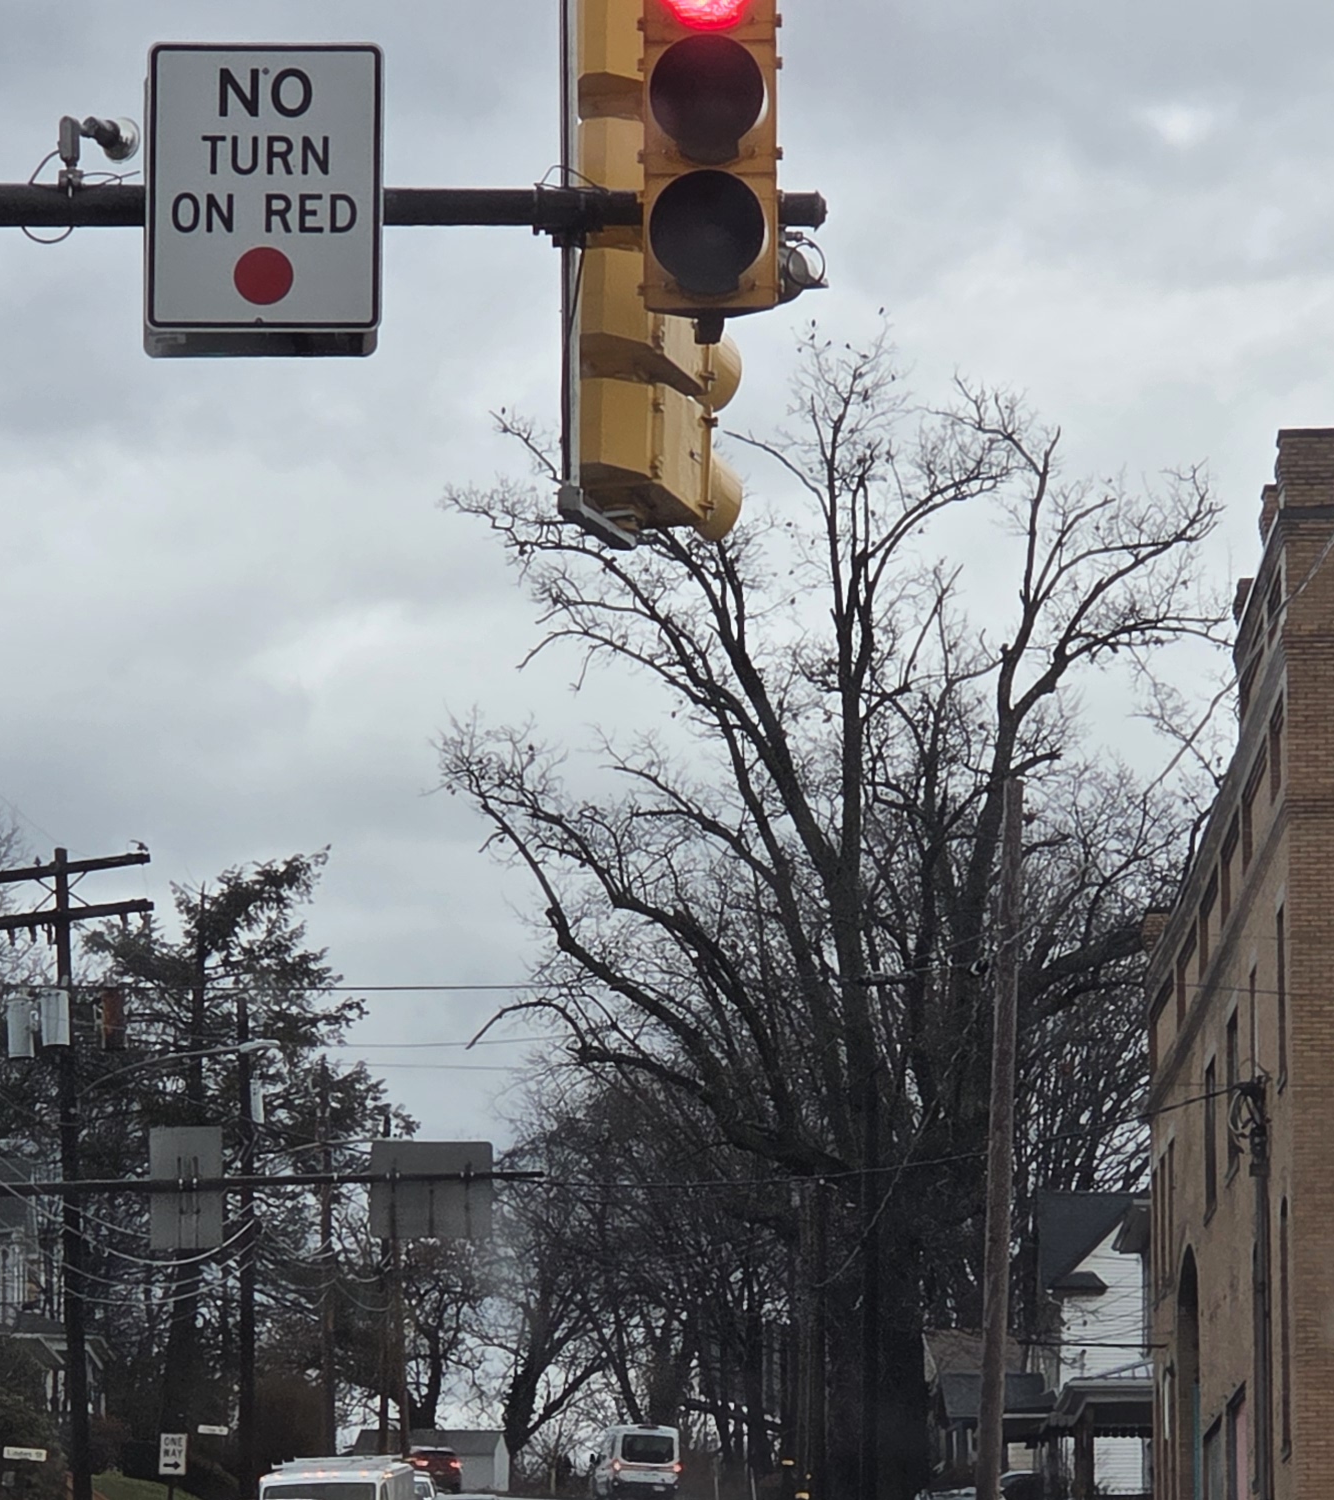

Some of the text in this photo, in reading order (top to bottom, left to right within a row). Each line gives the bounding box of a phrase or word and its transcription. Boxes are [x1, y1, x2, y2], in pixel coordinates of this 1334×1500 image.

[218, 67, 313, 118] NO
[201, 135, 330, 175] TURN
[171, 192, 358, 233] ON RED
[163, 1448, 183, 1459] WAY
[164, 1436, 183, 1448] ONE
